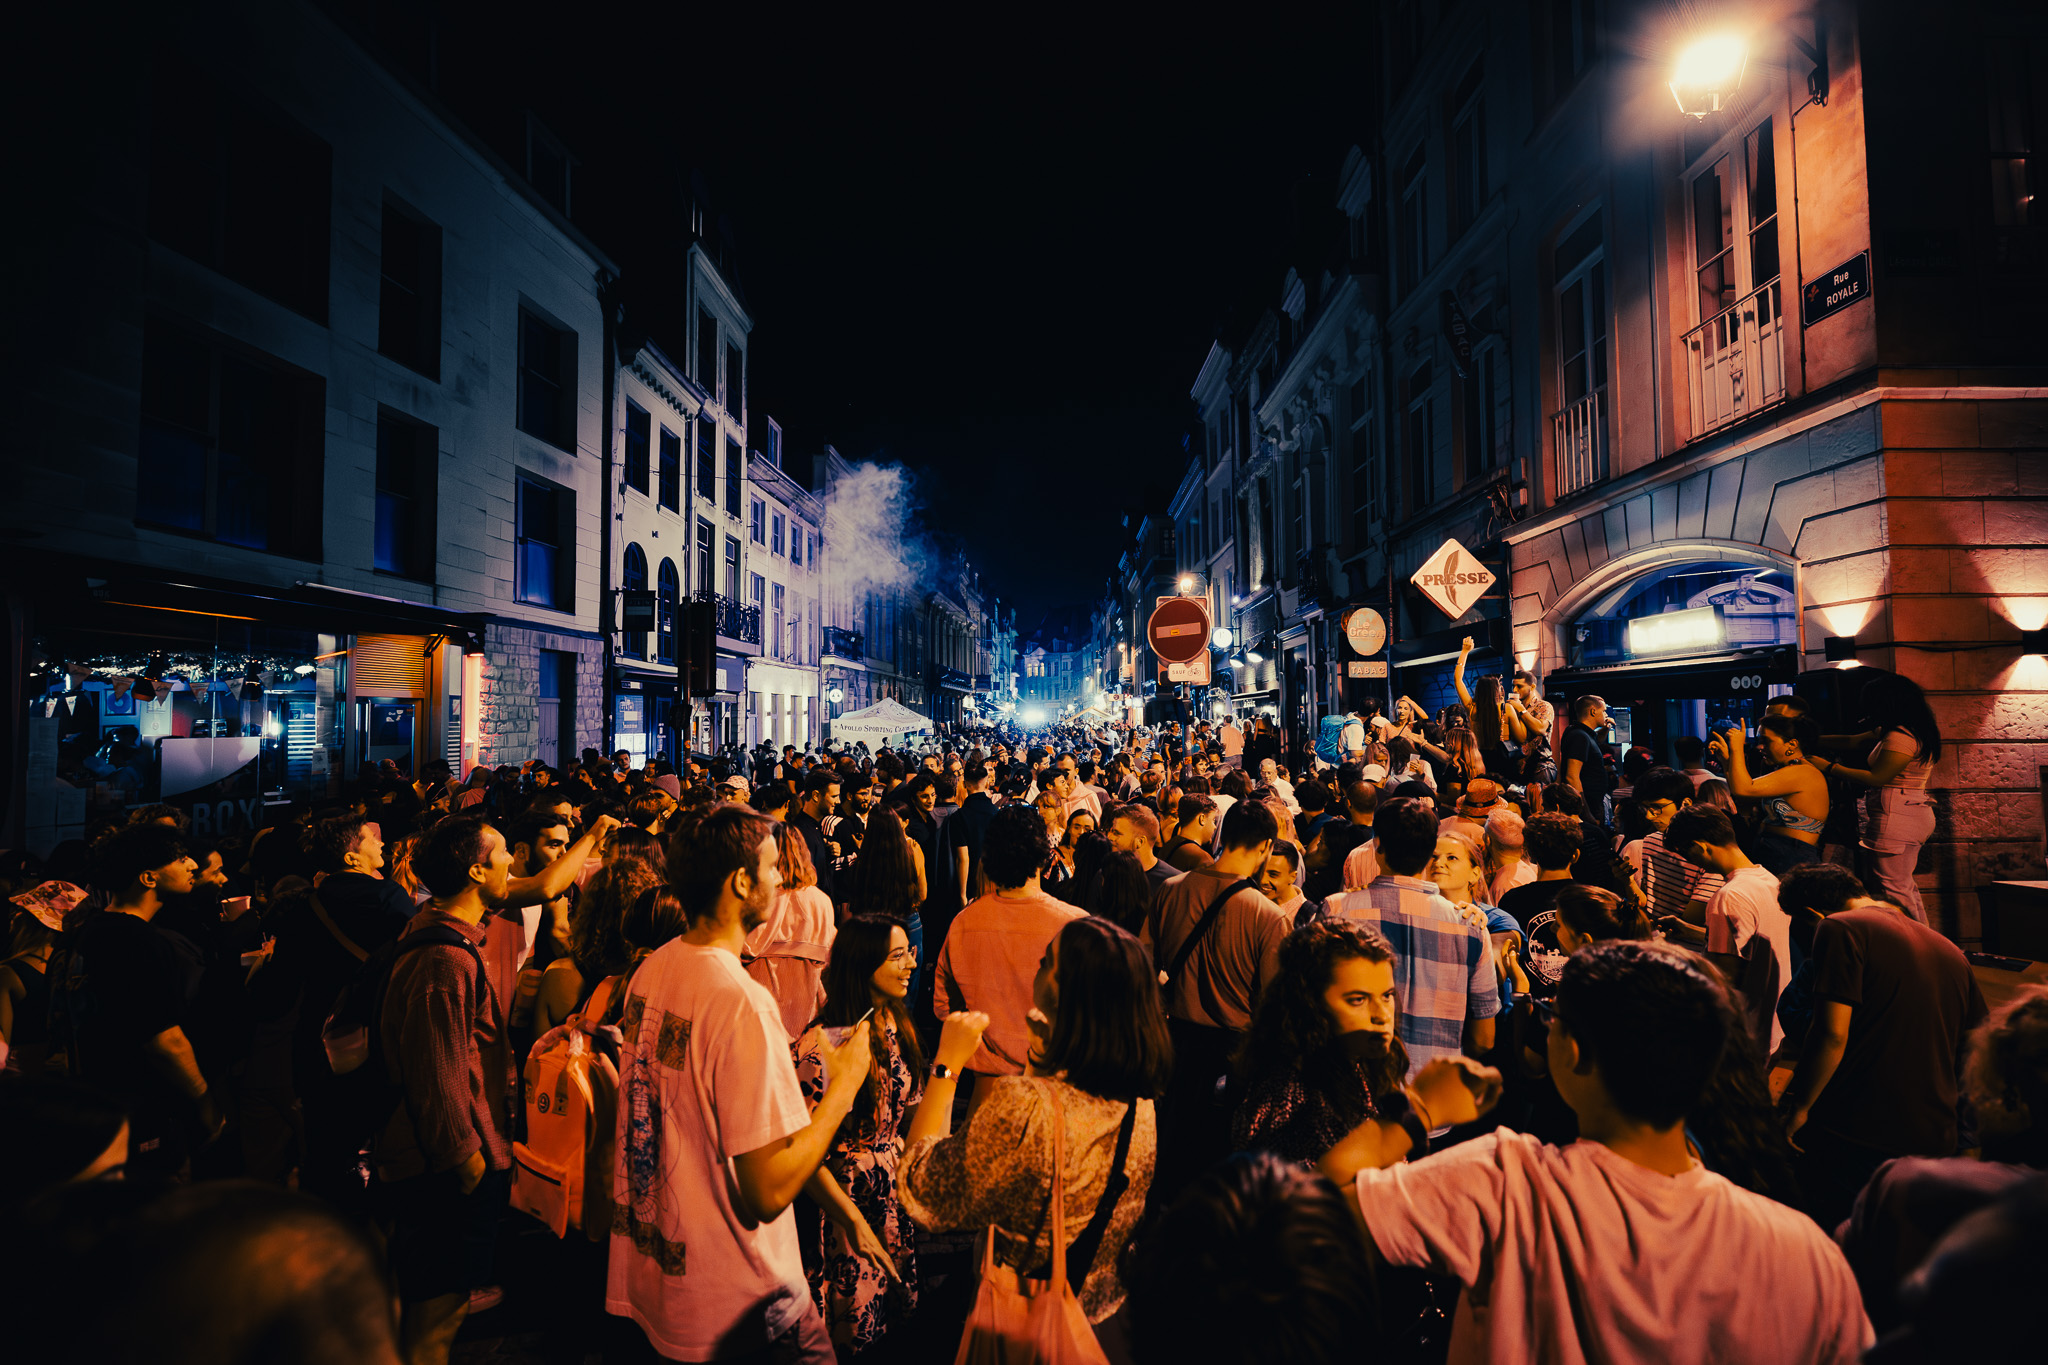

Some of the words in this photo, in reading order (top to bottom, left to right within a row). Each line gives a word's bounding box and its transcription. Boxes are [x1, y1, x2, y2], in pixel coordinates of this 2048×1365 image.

[1833, 271, 1849, 286] Rue
[1826, 281, 1859, 307] ROYALE
[1423, 572, 1489, 586] PRESSE
[1356, 619, 1370, 629] Le
[1349, 626, 1385, 638] Green
[1351, 666, 1386, 675] TABAC
[840, 723, 863, 732] APOLLO
[863, 724, 893, 734] SPORTING
[1532, 912, 1554, 926] THE
